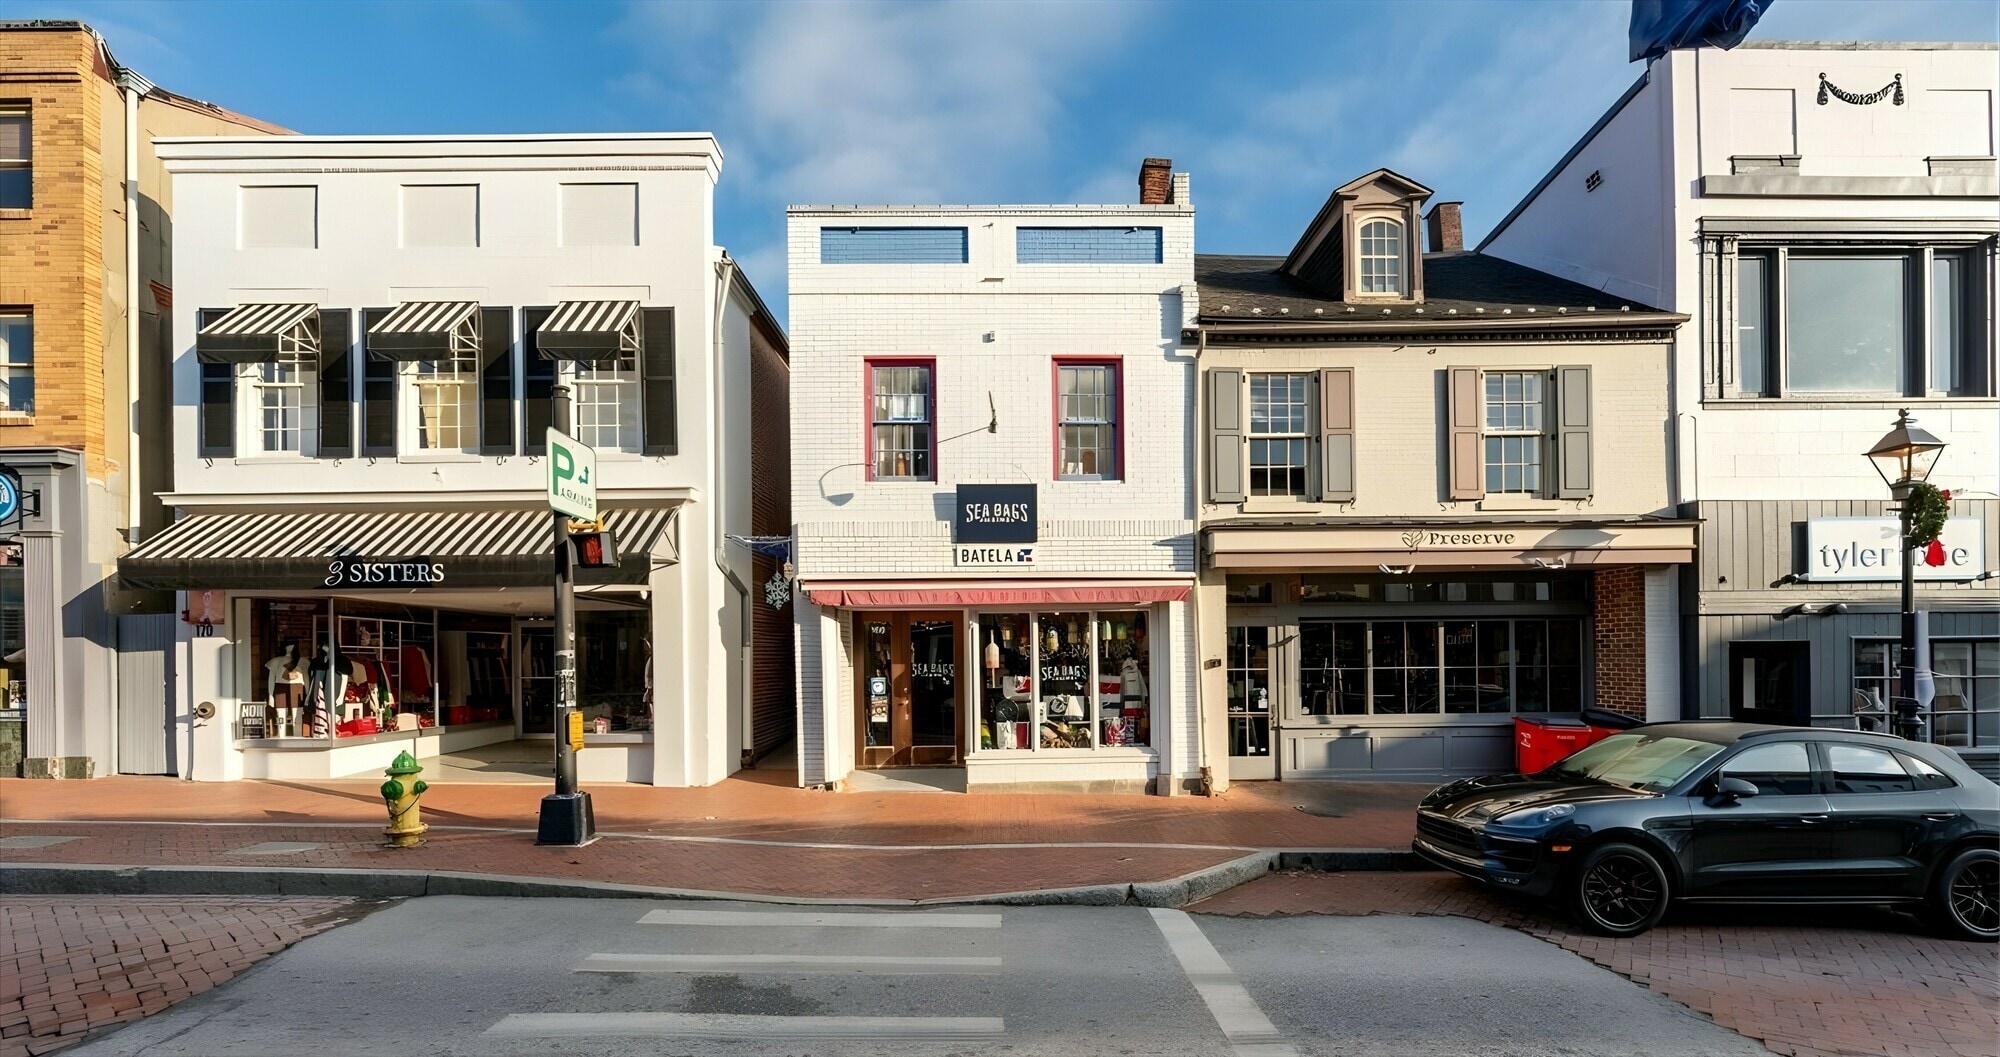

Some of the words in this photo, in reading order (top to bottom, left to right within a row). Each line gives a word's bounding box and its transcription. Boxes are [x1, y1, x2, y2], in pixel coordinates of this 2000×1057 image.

[552, 442, 575, 496] P
[966, 503, 990, 523] SEA
[1429, 532, 1516, 545] Preserve
[961, 548, 1013, 563] BATELA
[1820, 541, 1894, 574] tyler
[325, 560, 343, 586] 3
[349, 563, 445, 582] SISTERS
[196, 624, 213, 637] 170
